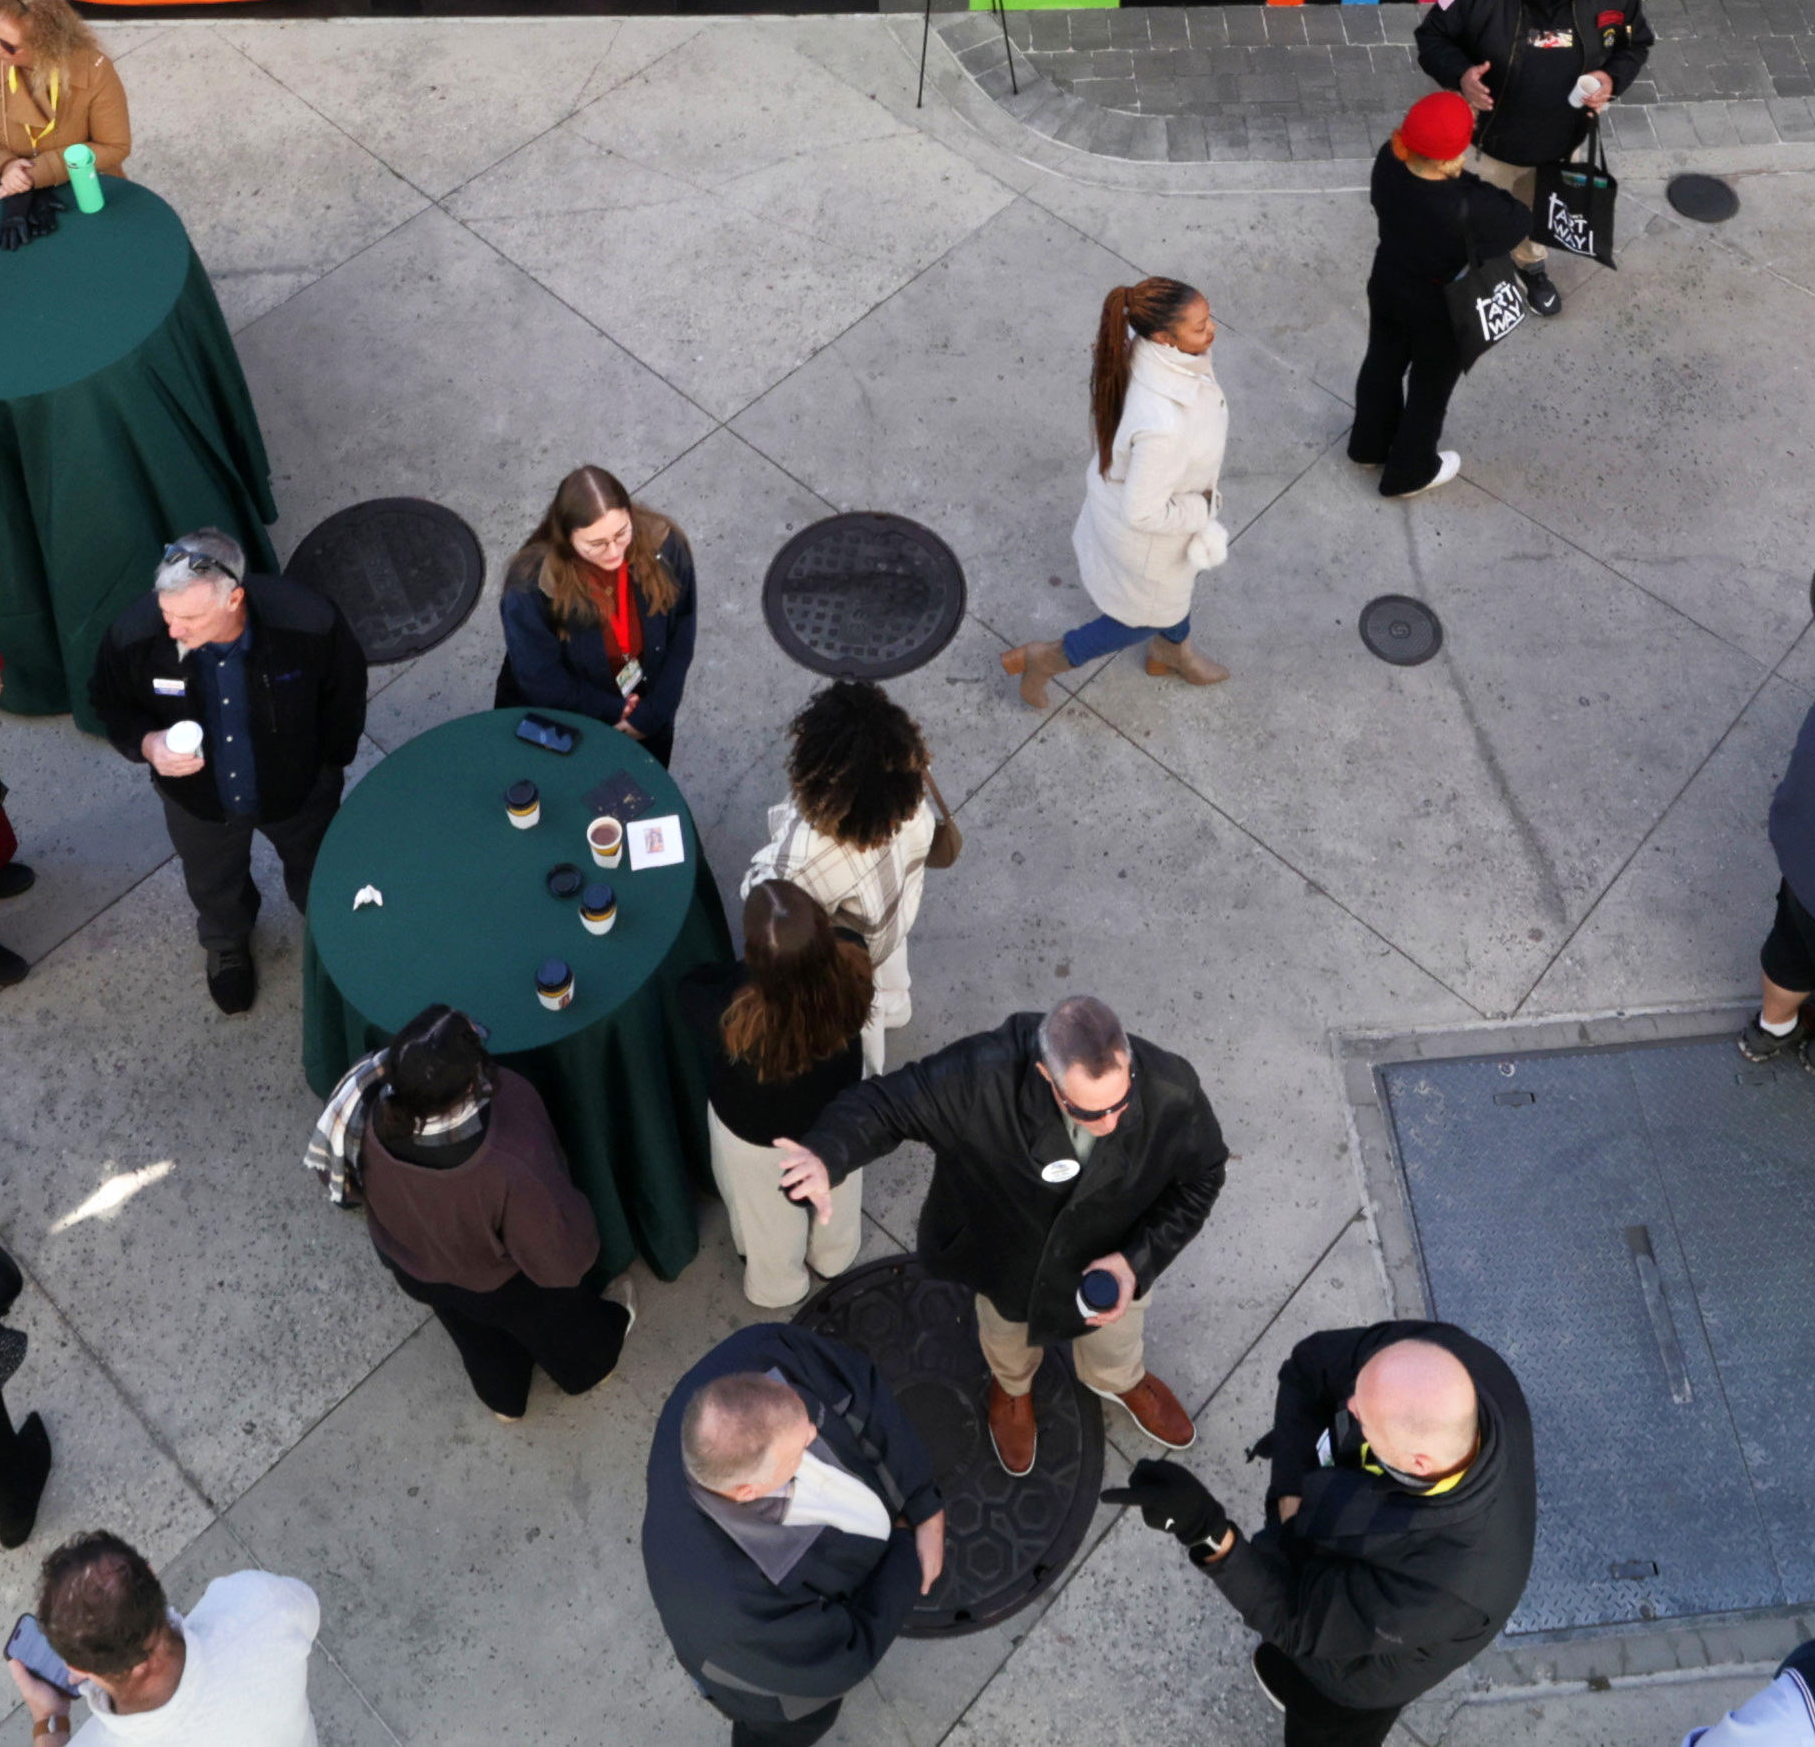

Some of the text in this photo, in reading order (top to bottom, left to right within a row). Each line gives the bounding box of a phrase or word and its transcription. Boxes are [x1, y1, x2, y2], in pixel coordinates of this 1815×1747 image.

[1553, 219, 1587, 250] WAY
[1488, 283, 1514, 320] ART
[1488, 300, 1521, 334] WAY
